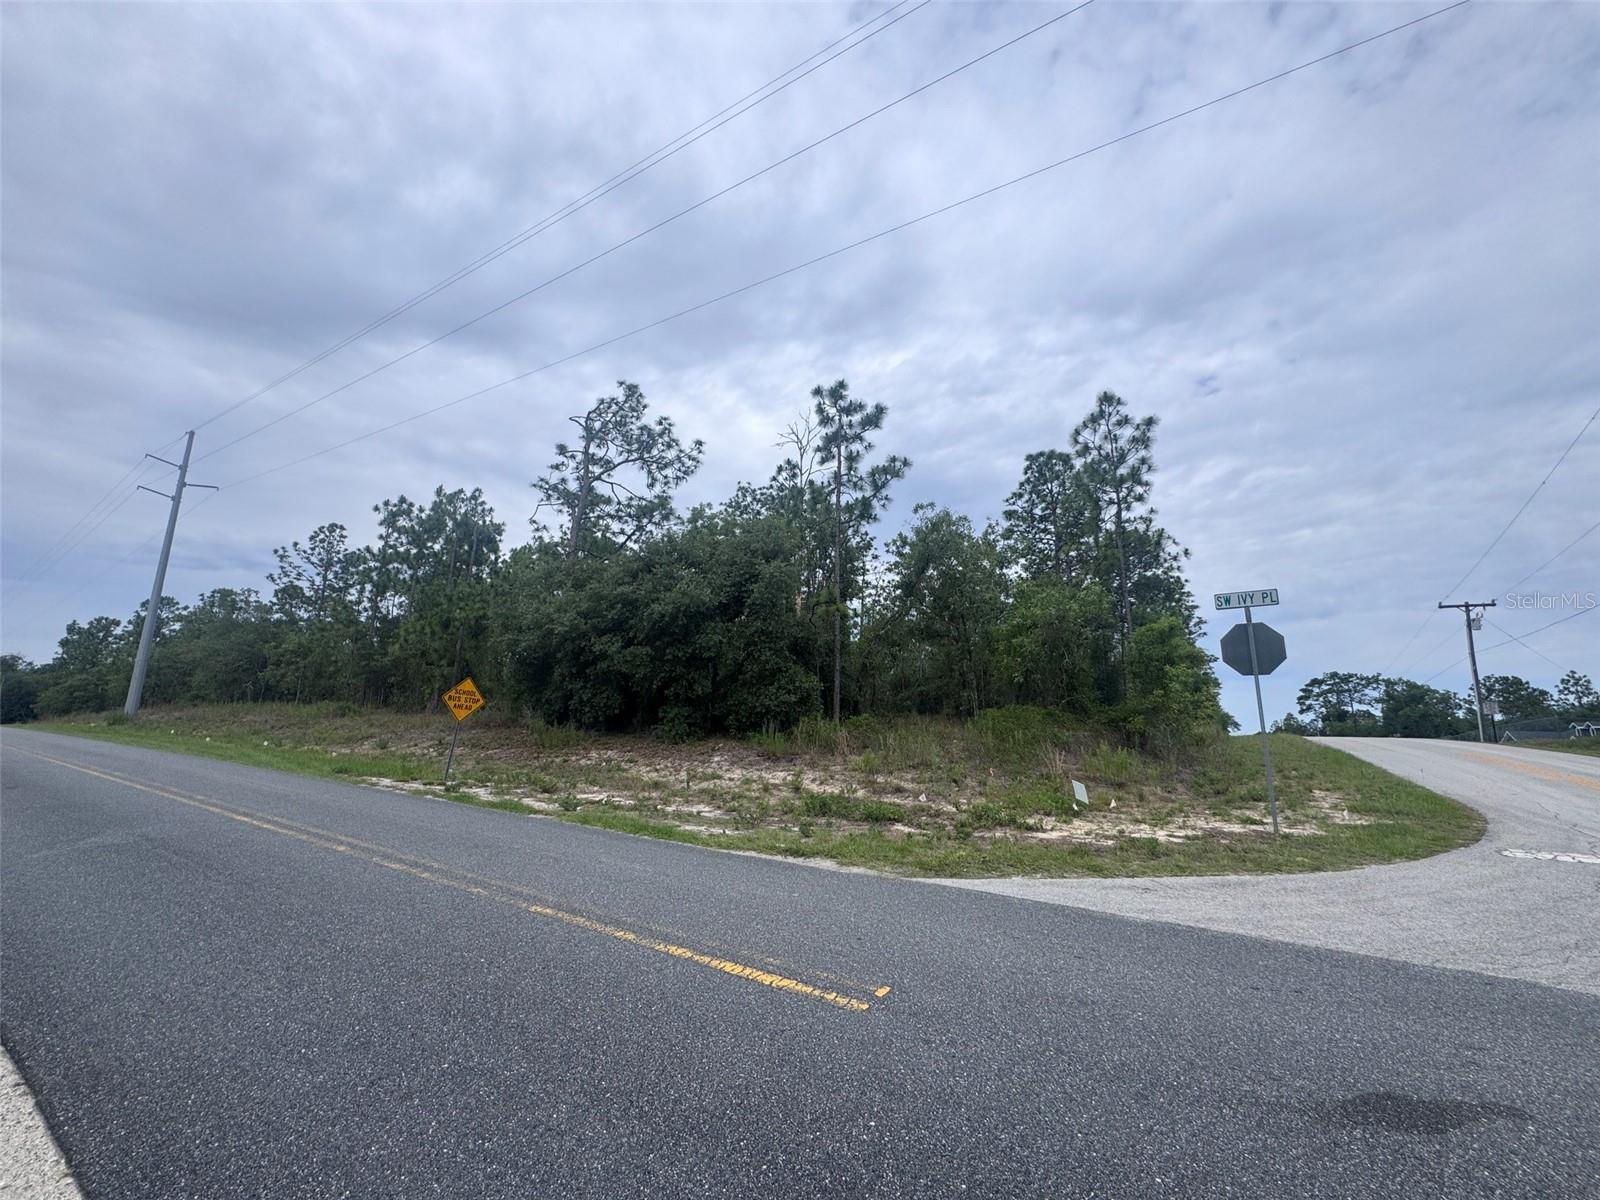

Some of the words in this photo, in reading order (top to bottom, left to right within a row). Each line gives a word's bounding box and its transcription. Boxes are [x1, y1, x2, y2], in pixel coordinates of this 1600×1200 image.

[1216, 595, 1231, 607] SW
[1237, 593, 1255, 605] IVY
[1261, 591, 1276, 603] PL
[454, 688, 477, 698] SCHOOL
[447, 694, 461, 702] BUS
[464, 697, 481, 705] STOP
[453, 703, 473, 711] AHEAD
